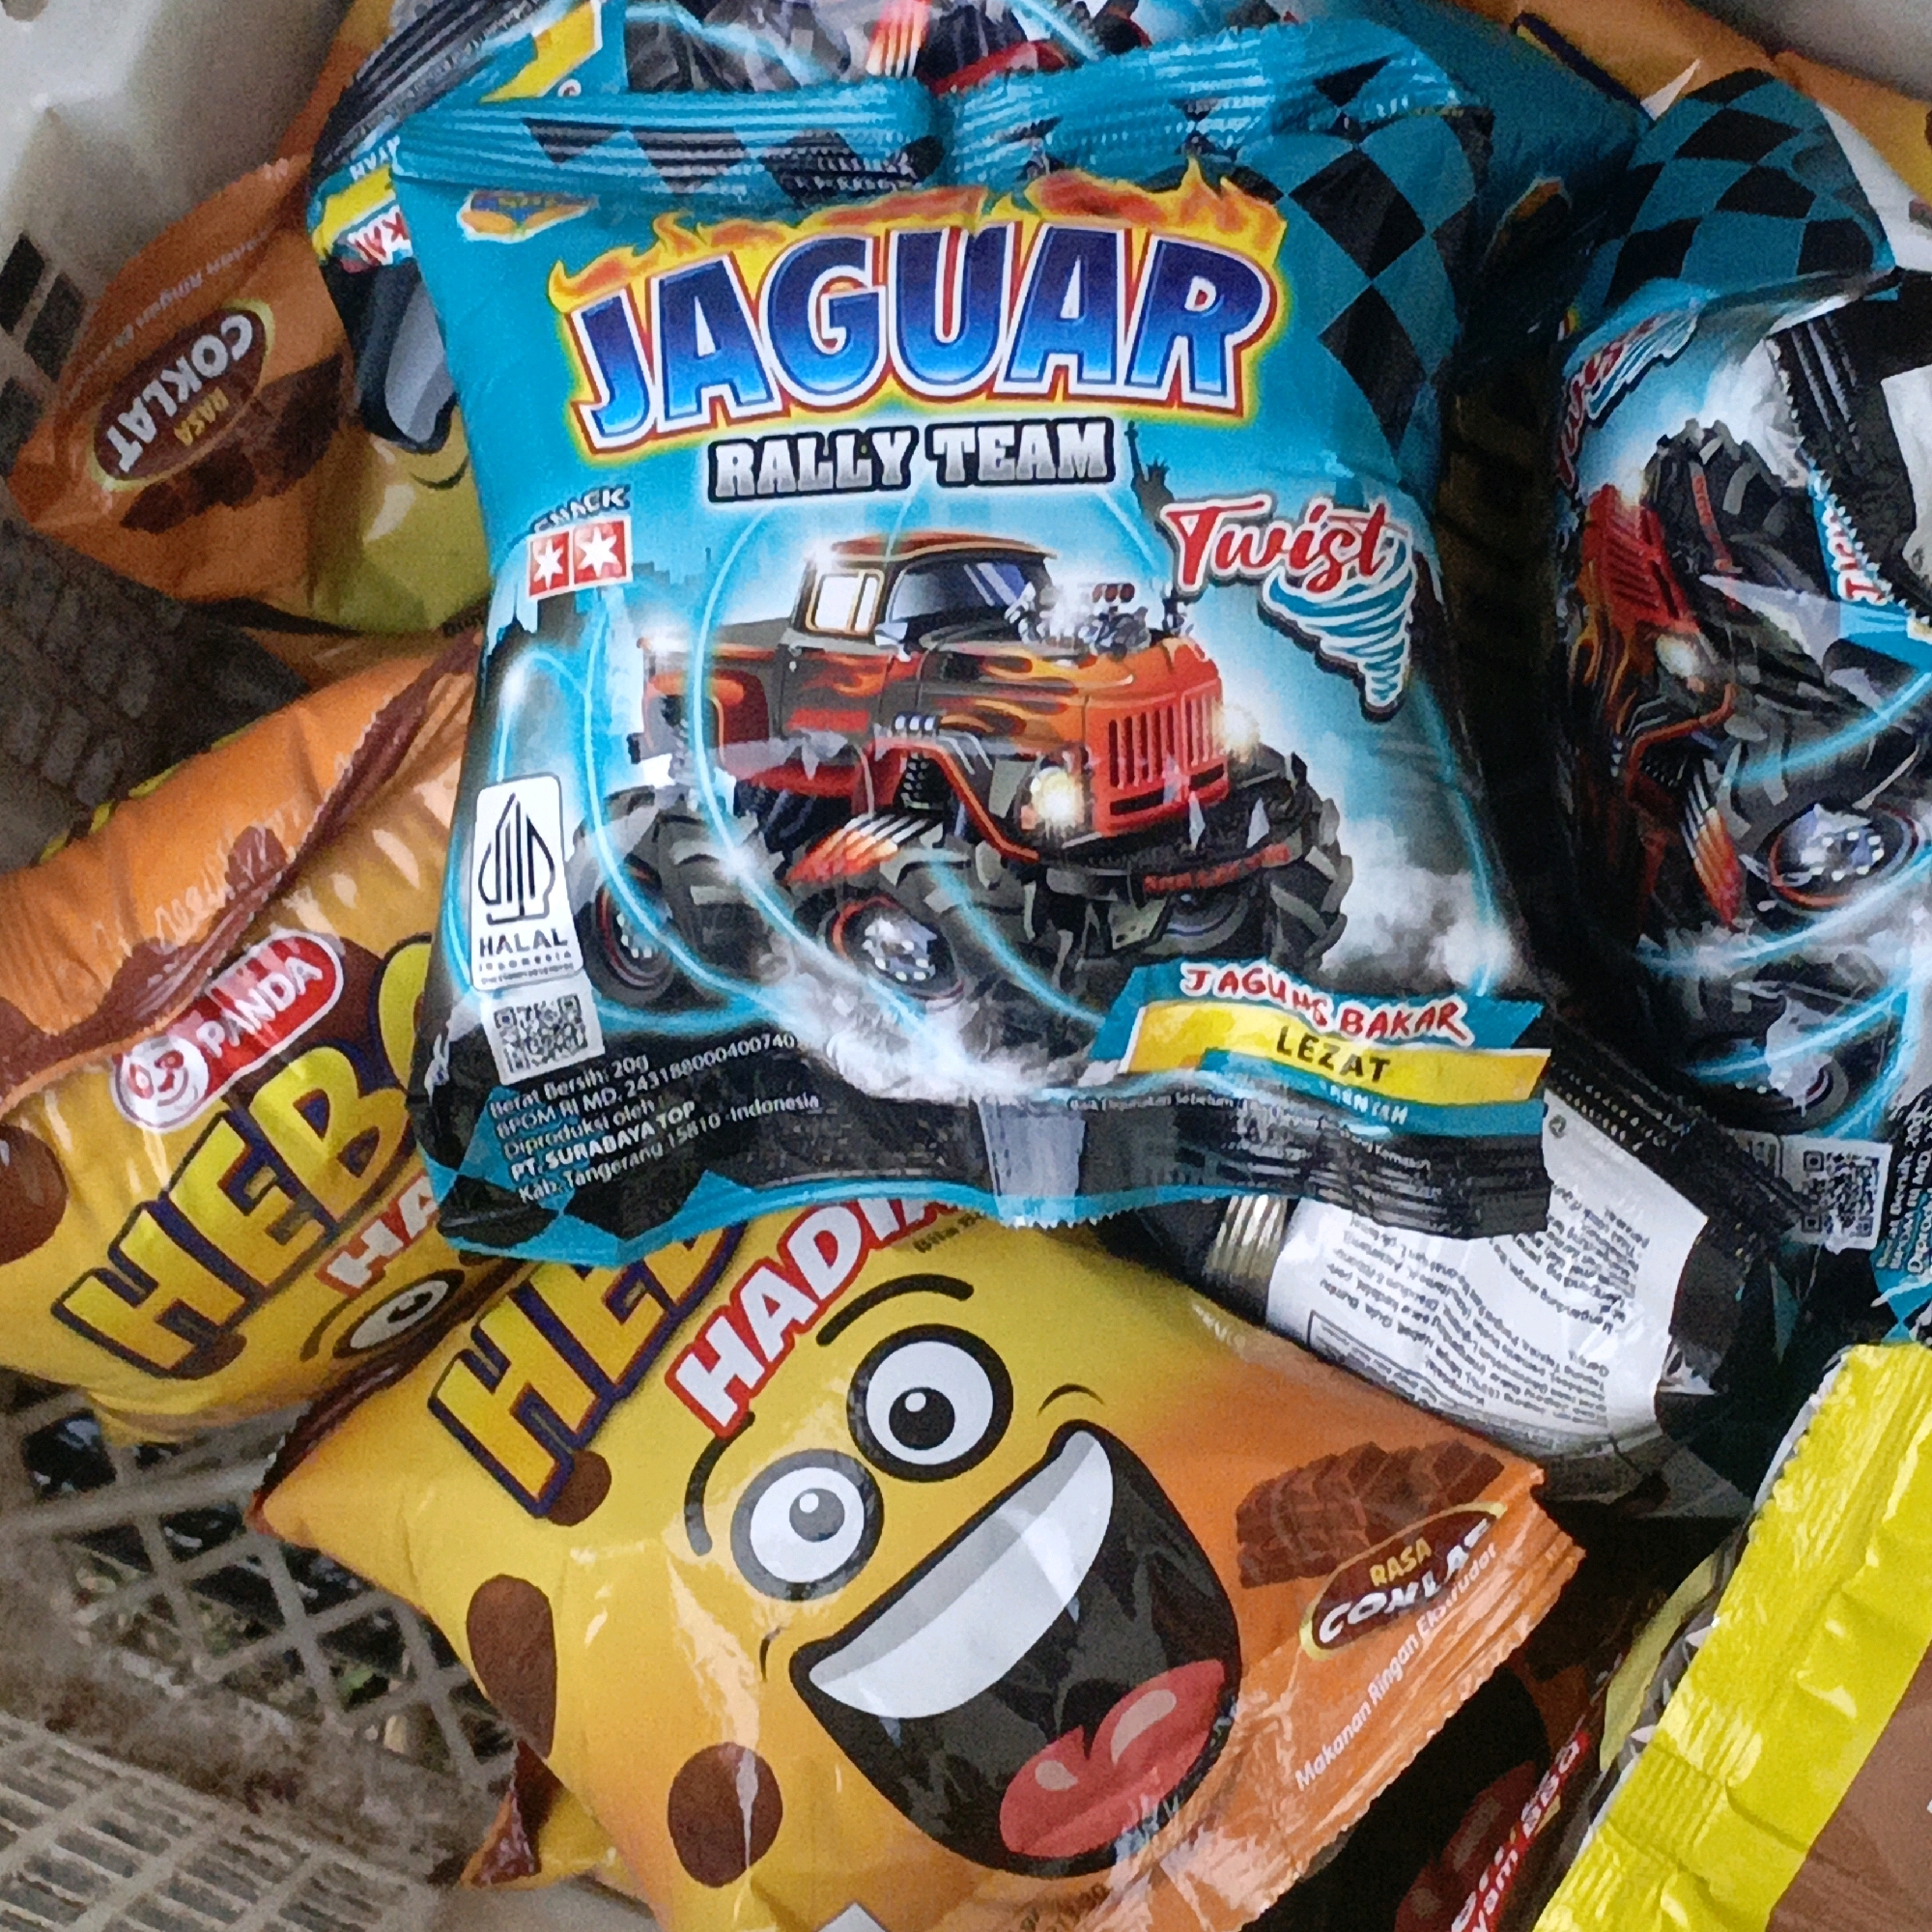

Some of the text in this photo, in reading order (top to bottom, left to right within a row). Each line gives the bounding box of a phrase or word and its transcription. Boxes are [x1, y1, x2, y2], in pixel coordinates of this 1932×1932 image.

[568, 221, 1278, 453] JAGUAR
[106, 313, 255, 472] COKLAT
[174, 387, 231, 448] RASA
[710, 416, 1116, 502] RALLY TEAM
[1160, 494, 1410, 597] Twist
[479, 928, 568, 957] HALAL
[196, 953, 325, 1059] PANDA
[1182, 965, 1470, 1043] JAGUNG BAKAR
[1276, 1025, 1391, 1083] LEZAT
[504, 1113, 611, 1160] Diproduksi
[545, 1121, 656, 1170] SURABAYA
[655, 1100, 696, 1130] TOP
[562, 1141, 665, 1189] Tangerang
[665, 1198, 952, 1439] HADI
[1369, 1536, 1433, 1587] RASA
[1294, 1700, 1373, 1791] Makanan
[1368, 1634, 1419, 1707] Ringan
